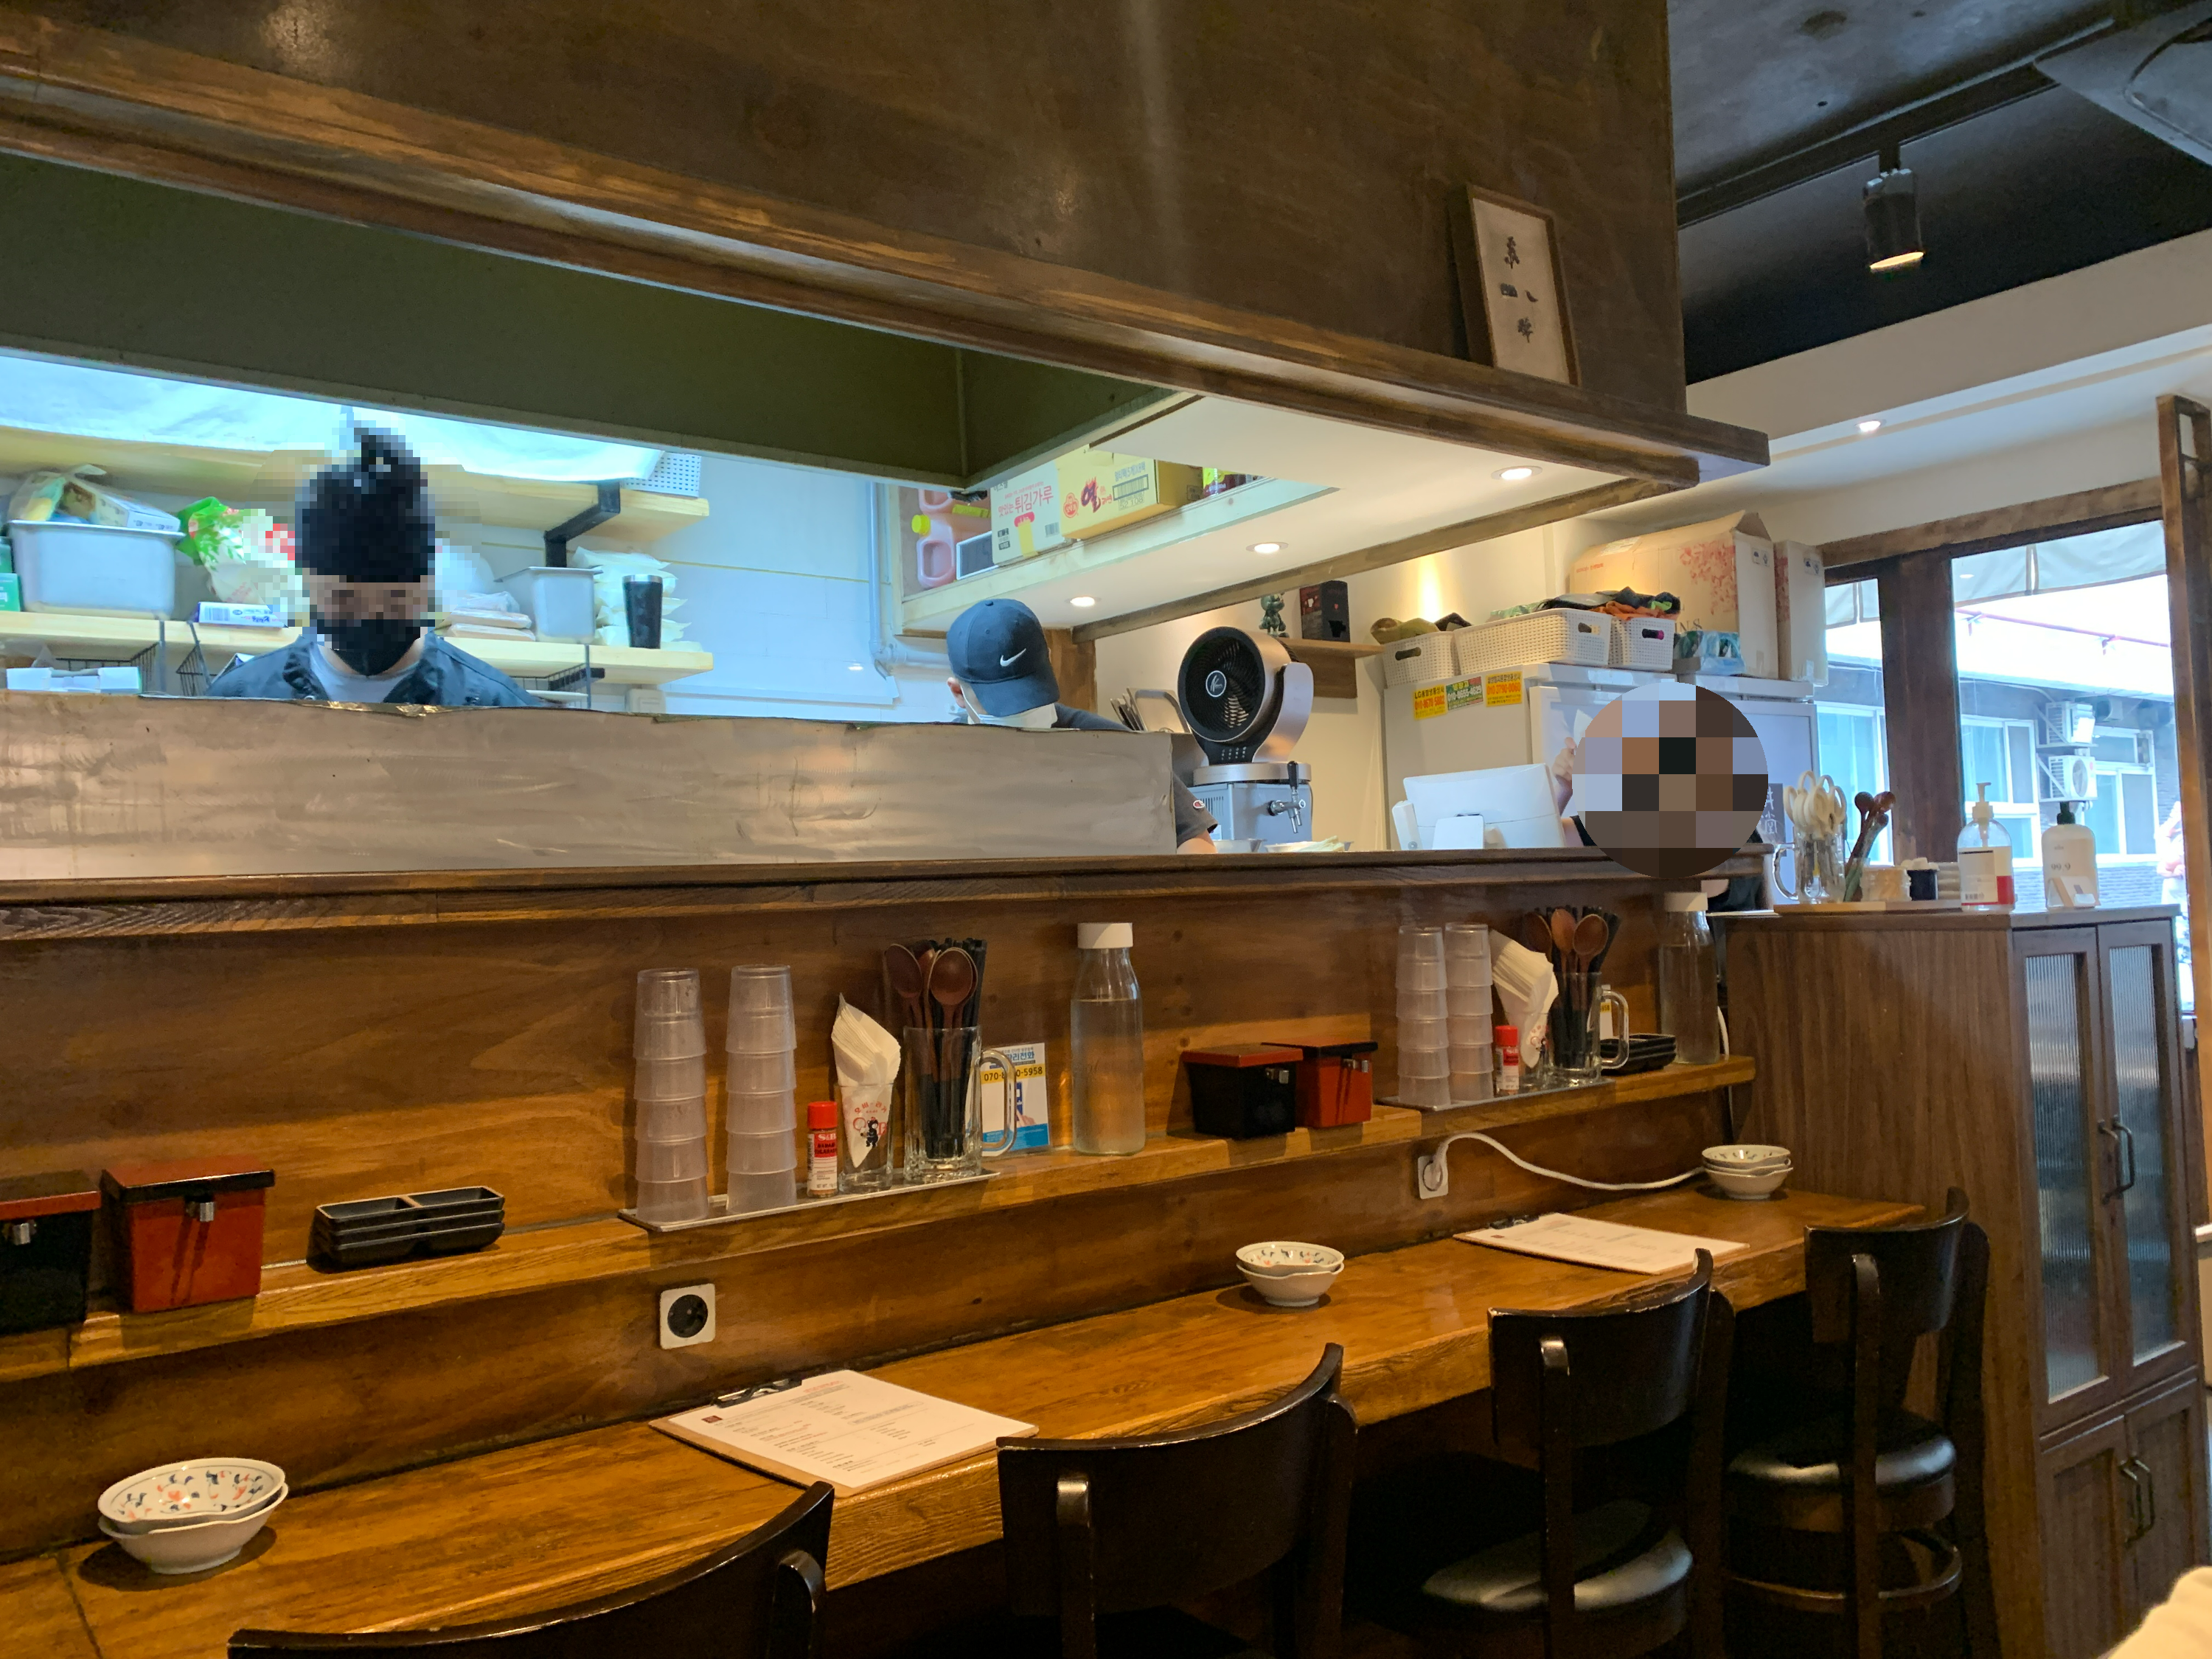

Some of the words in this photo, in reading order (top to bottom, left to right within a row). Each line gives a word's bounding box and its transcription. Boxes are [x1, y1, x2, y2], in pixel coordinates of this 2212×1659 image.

[998, 503, 1014, 517] 맛있는
[1015, 485, 1054, 513] 튀김가루
[984, 1066, 1043, 1082] 070-80-5958
